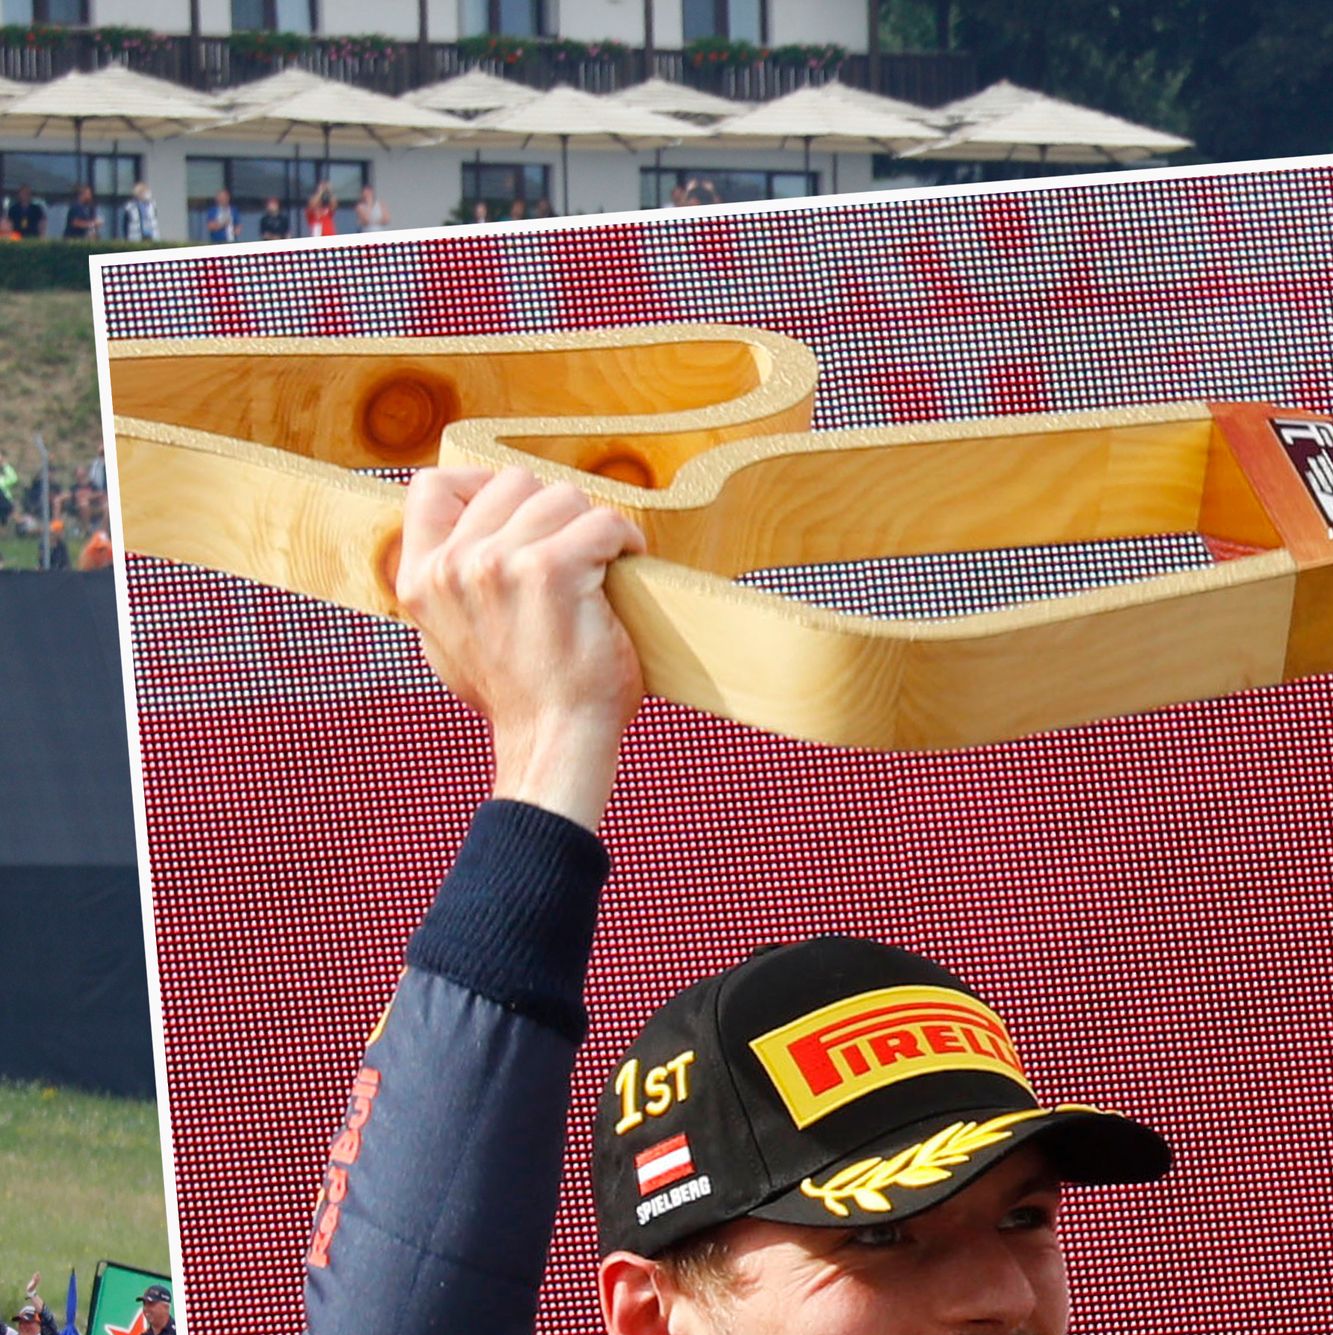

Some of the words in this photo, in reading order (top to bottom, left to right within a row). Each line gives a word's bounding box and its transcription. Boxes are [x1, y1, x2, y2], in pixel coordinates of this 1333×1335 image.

[788, 1001, 1024, 1096] PIRELLI
[614, 1050, 696, 1135] 1ST
[636, 1175, 711, 1226] SPIELBERG
